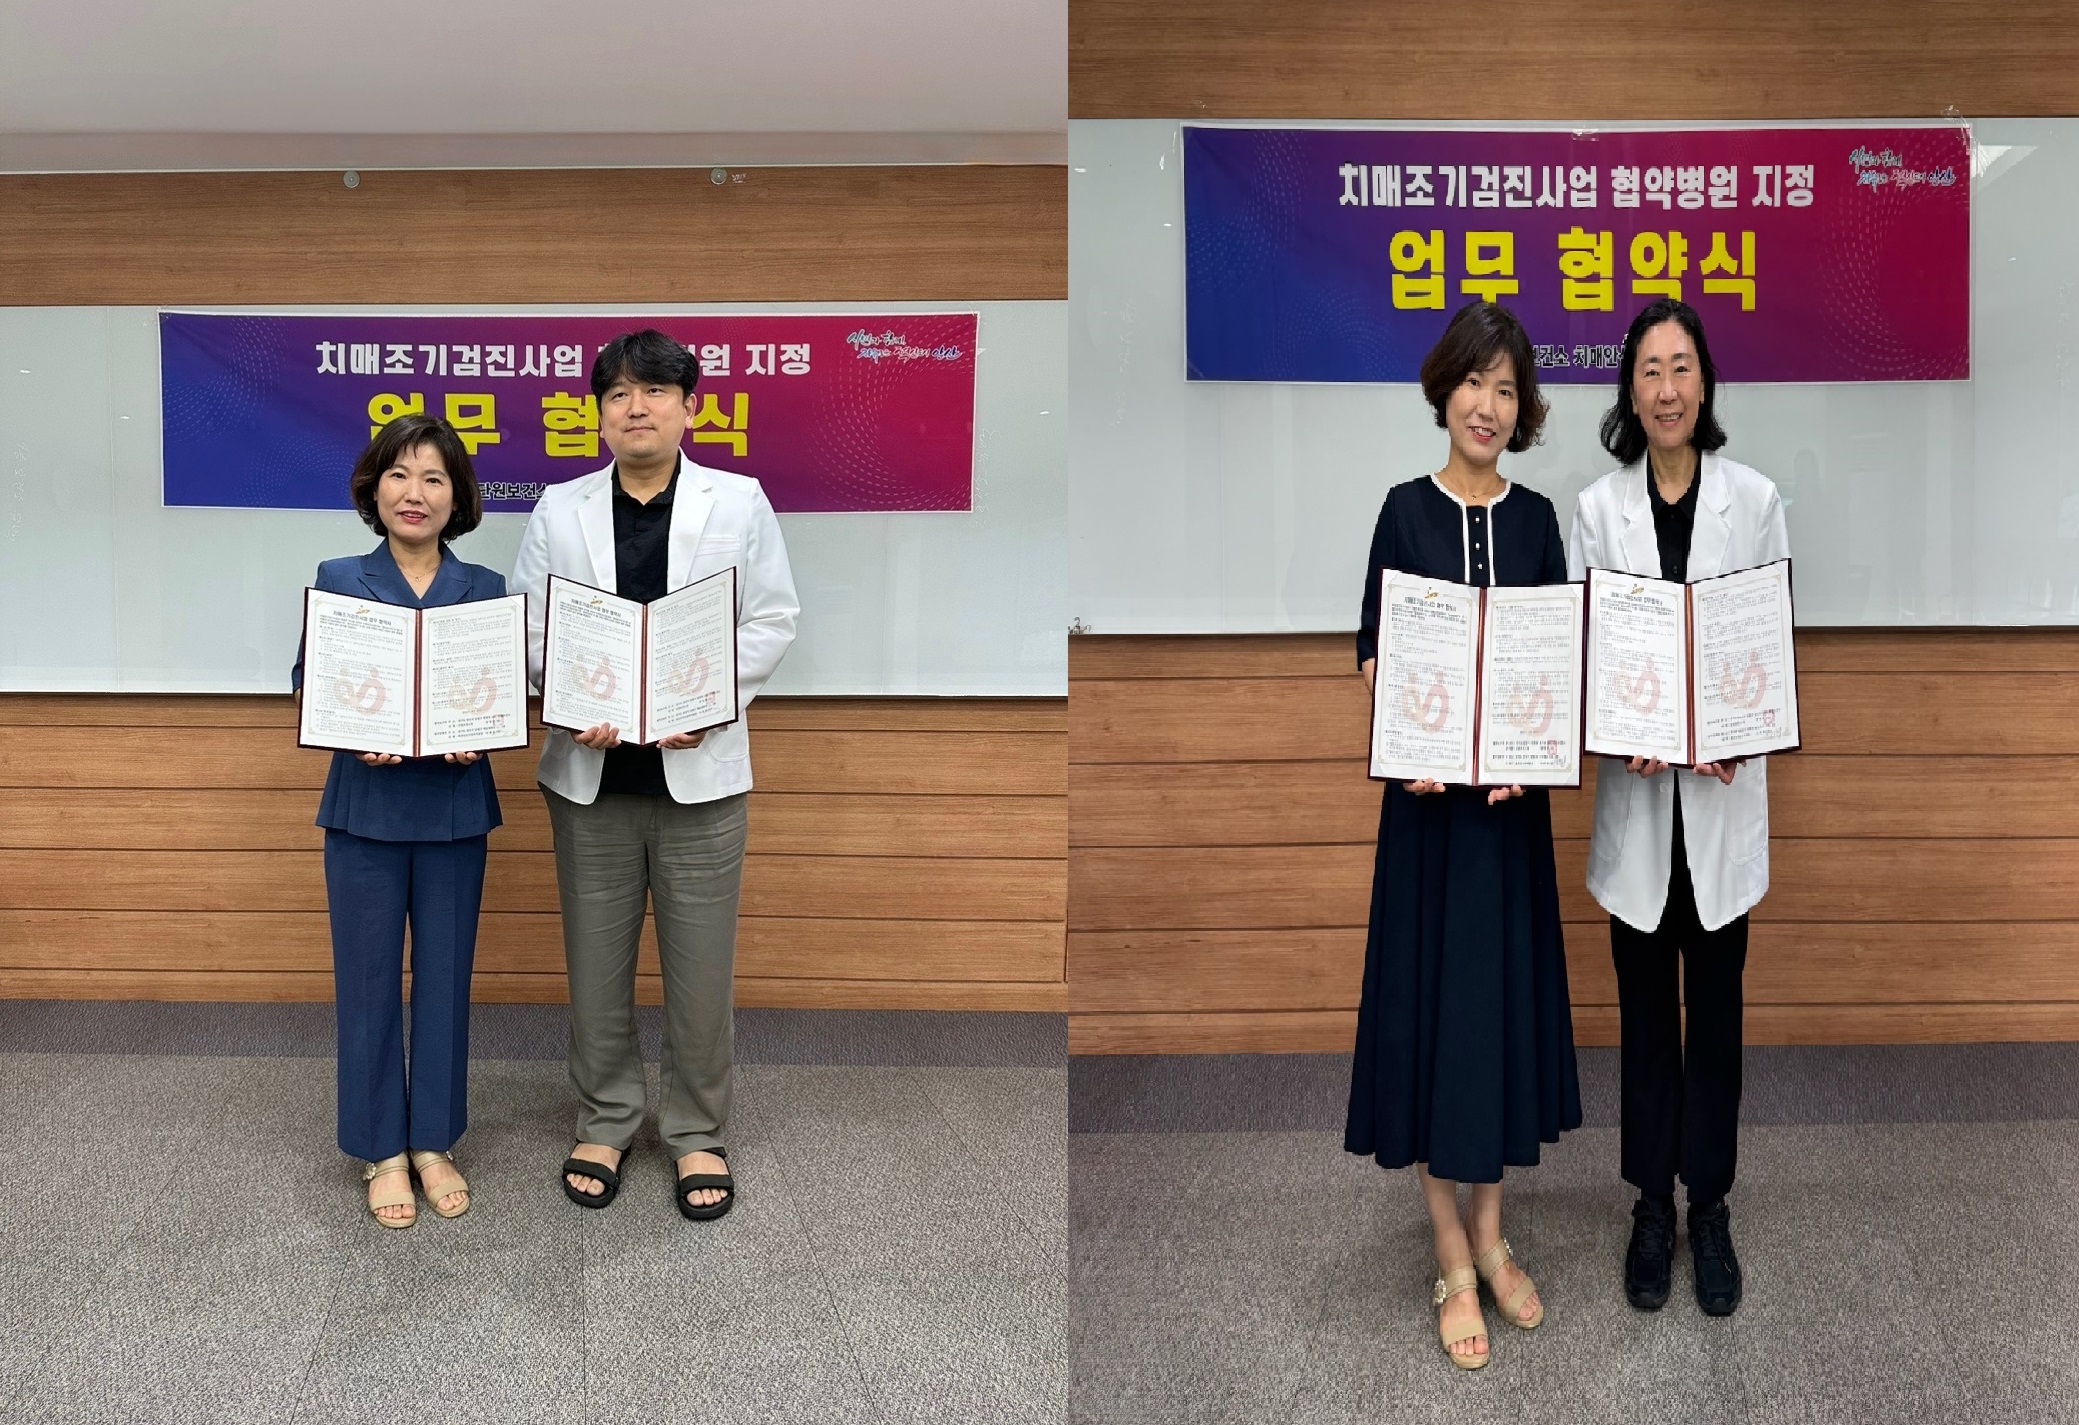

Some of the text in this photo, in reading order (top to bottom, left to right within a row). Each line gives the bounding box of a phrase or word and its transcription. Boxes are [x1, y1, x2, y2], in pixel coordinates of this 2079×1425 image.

[1338, 163, 1814, 210] 치매조기검진사업 협약병원 지정
[1389, 225, 1756, 312] 업무 협약식
[316, 341, 582, 377] 치매조기검진사업
[745, 343, 811, 377] 지정
[1573, 344, 1626, 369] 치매안
[541, 391, 749, 457] 협식
